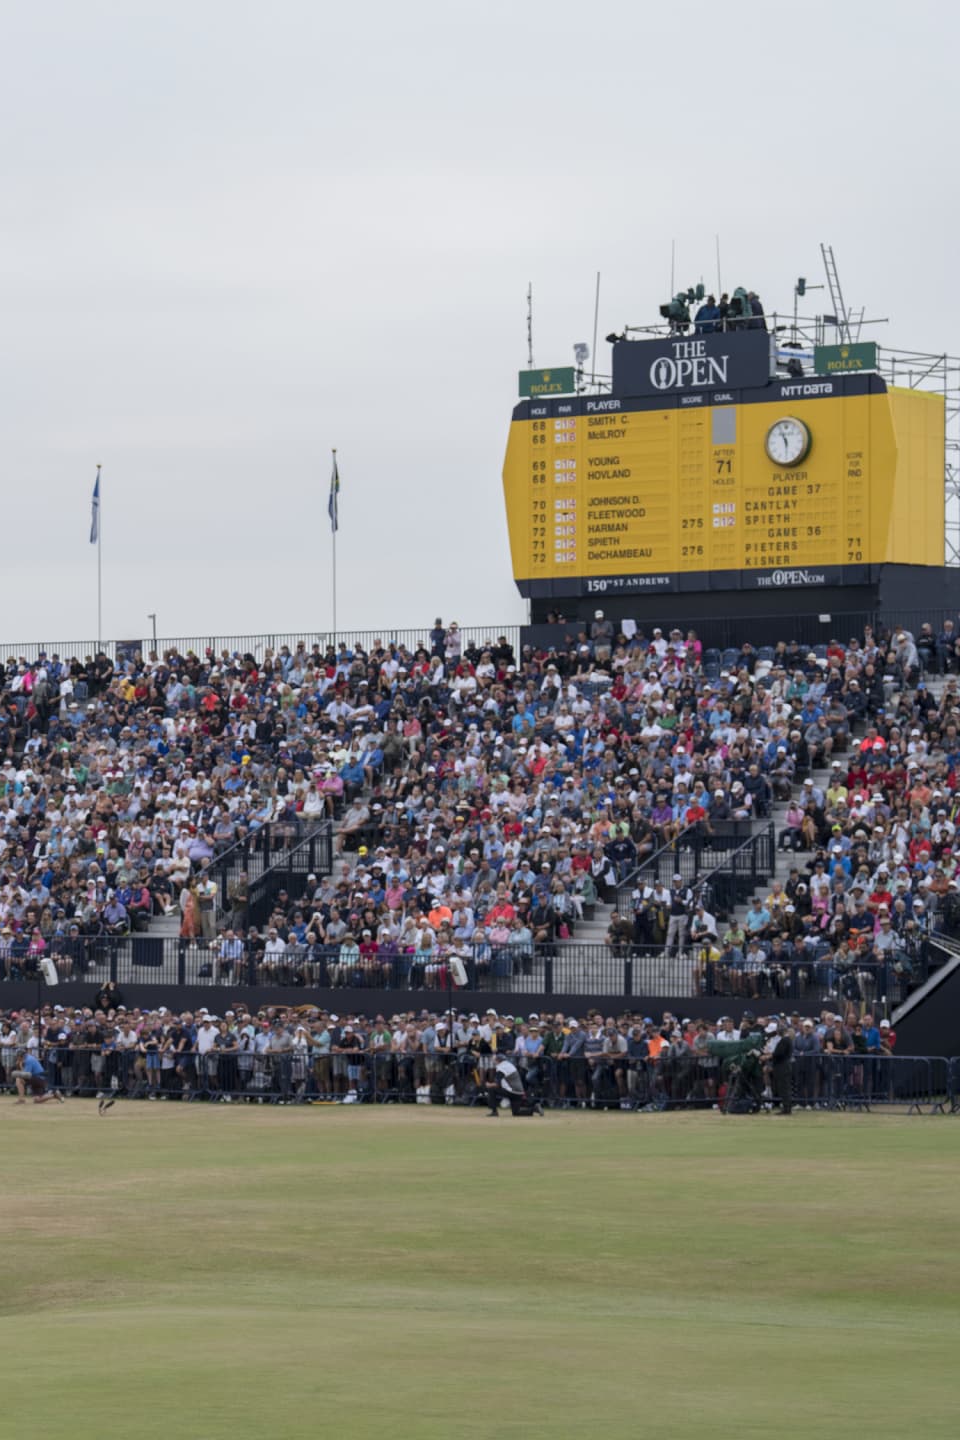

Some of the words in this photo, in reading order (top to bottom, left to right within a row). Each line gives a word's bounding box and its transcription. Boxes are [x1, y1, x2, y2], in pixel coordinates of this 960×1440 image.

[672, 340, 706, 359] THE
[827, 359, 863, 369] ROLEX
[649, 356, 729, 390] OPEN
[530, 384, 562, 393] ROLEX
[781, 385, 803, 397] NTT
[587, 400, 621, 411] PLAYER
[587, 416, 616, 427] SMITH
[713, 448, 735, 456] AFTER
[587, 456, 620, 467] YOUNG
[716, 459, 732, 474] 71
[587, 469, 631, 480] HOVLAND
[773, 472, 808, 481] PLAYER
[768, 485, 798, 496] GAME
[807, 484, 822, 494] 37
[588, 496, 630, 507] JOHNSON
[745, 499, 798, 512] CANTLAY
[587, 508, 646, 520] FLEETWOOD
[745, 513, 791, 526] SPIETH
[587, 522, 629, 534] HARMAN
[682, 518, 704, 529] 275
[768, 527, 798, 538] GAME
[807, 526, 822, 536] 36
[532, 540, 546, 550] 71
[587, 537, 620, 547] SPIETH
[745, 541, 798, 553] PIETERS
[847, 537, 862, 547] 71
[587, 548, 652, 560] DeCHAMBEAU
[745, 555, 791, 567] KISNER
[847, 551, 862, 562] 70
[613, 578, 624, 587] ST
[626, 577, 670, 586] ANDREWS
